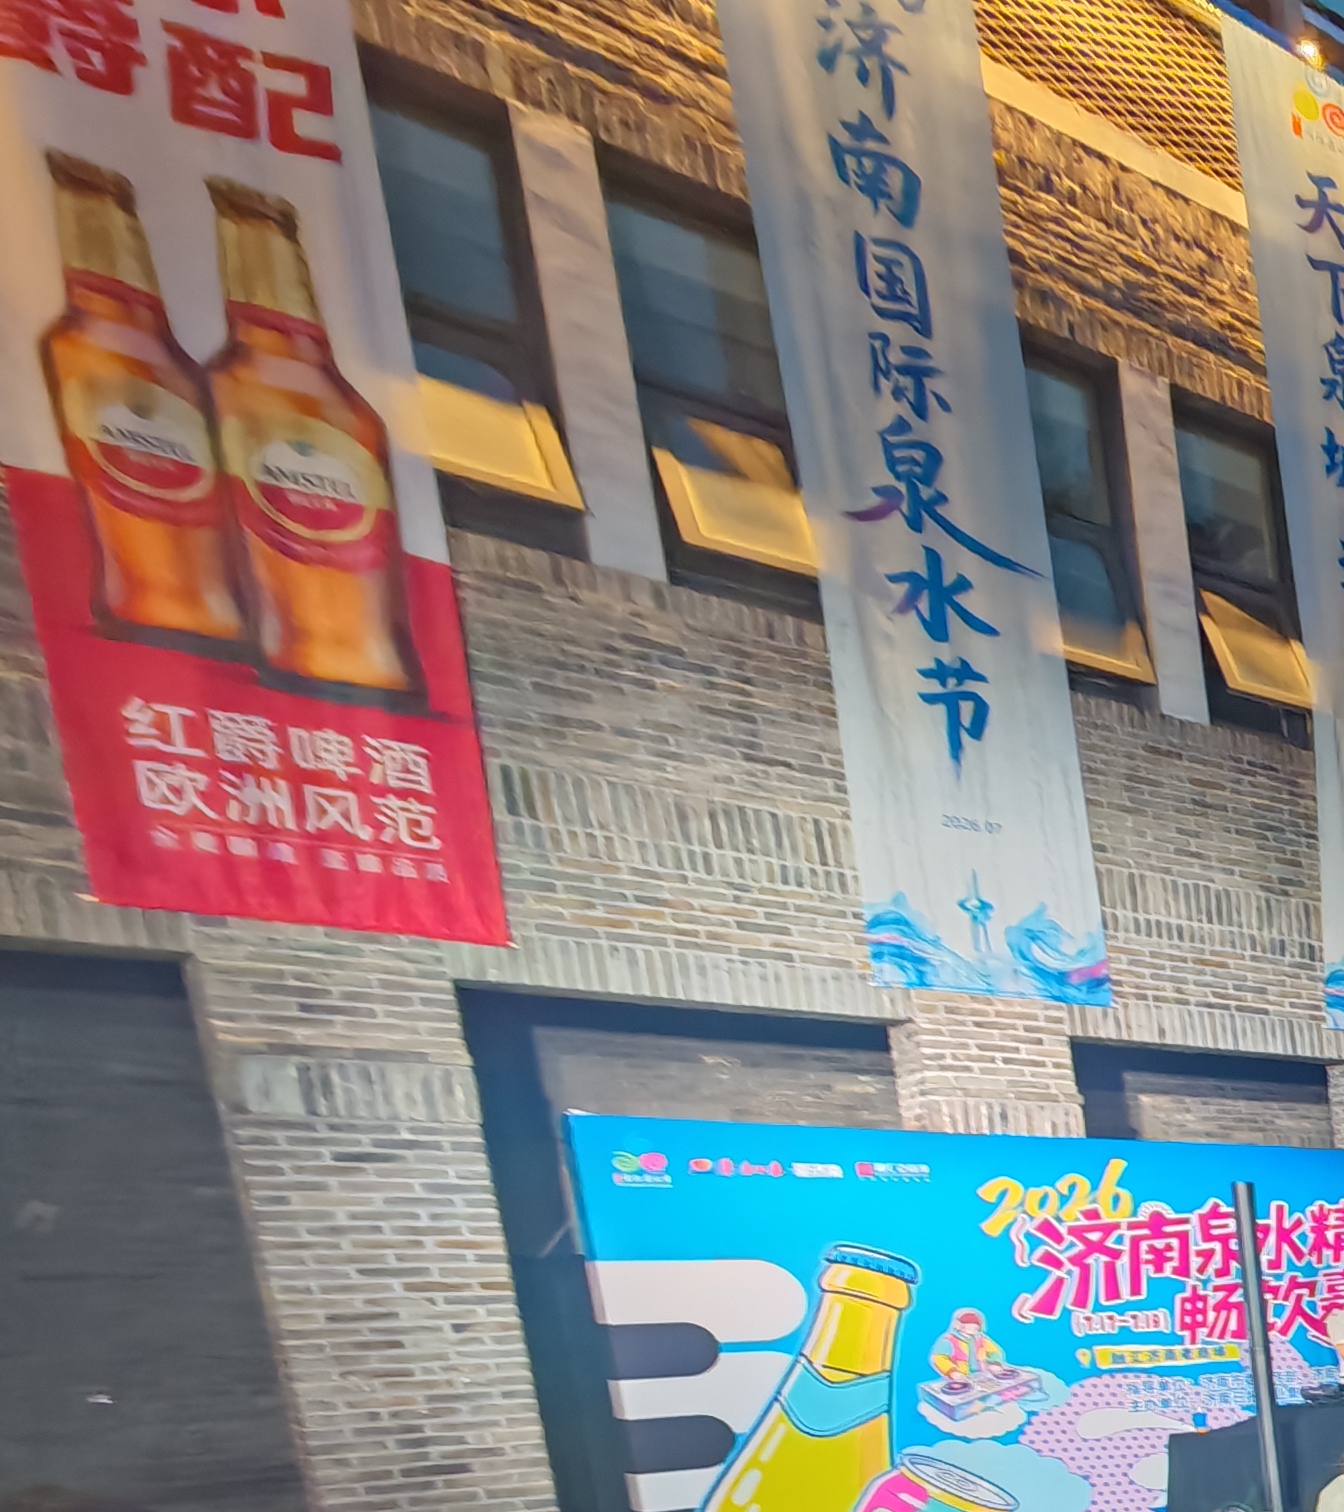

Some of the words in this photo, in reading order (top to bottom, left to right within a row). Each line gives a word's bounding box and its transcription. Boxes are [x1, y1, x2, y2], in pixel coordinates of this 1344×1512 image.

[121, 696, 436, 795] 红爵啤酒
[134, 759, 442, 851] 欧洲风范
[976, 1158, 1134, 1239] 2026
